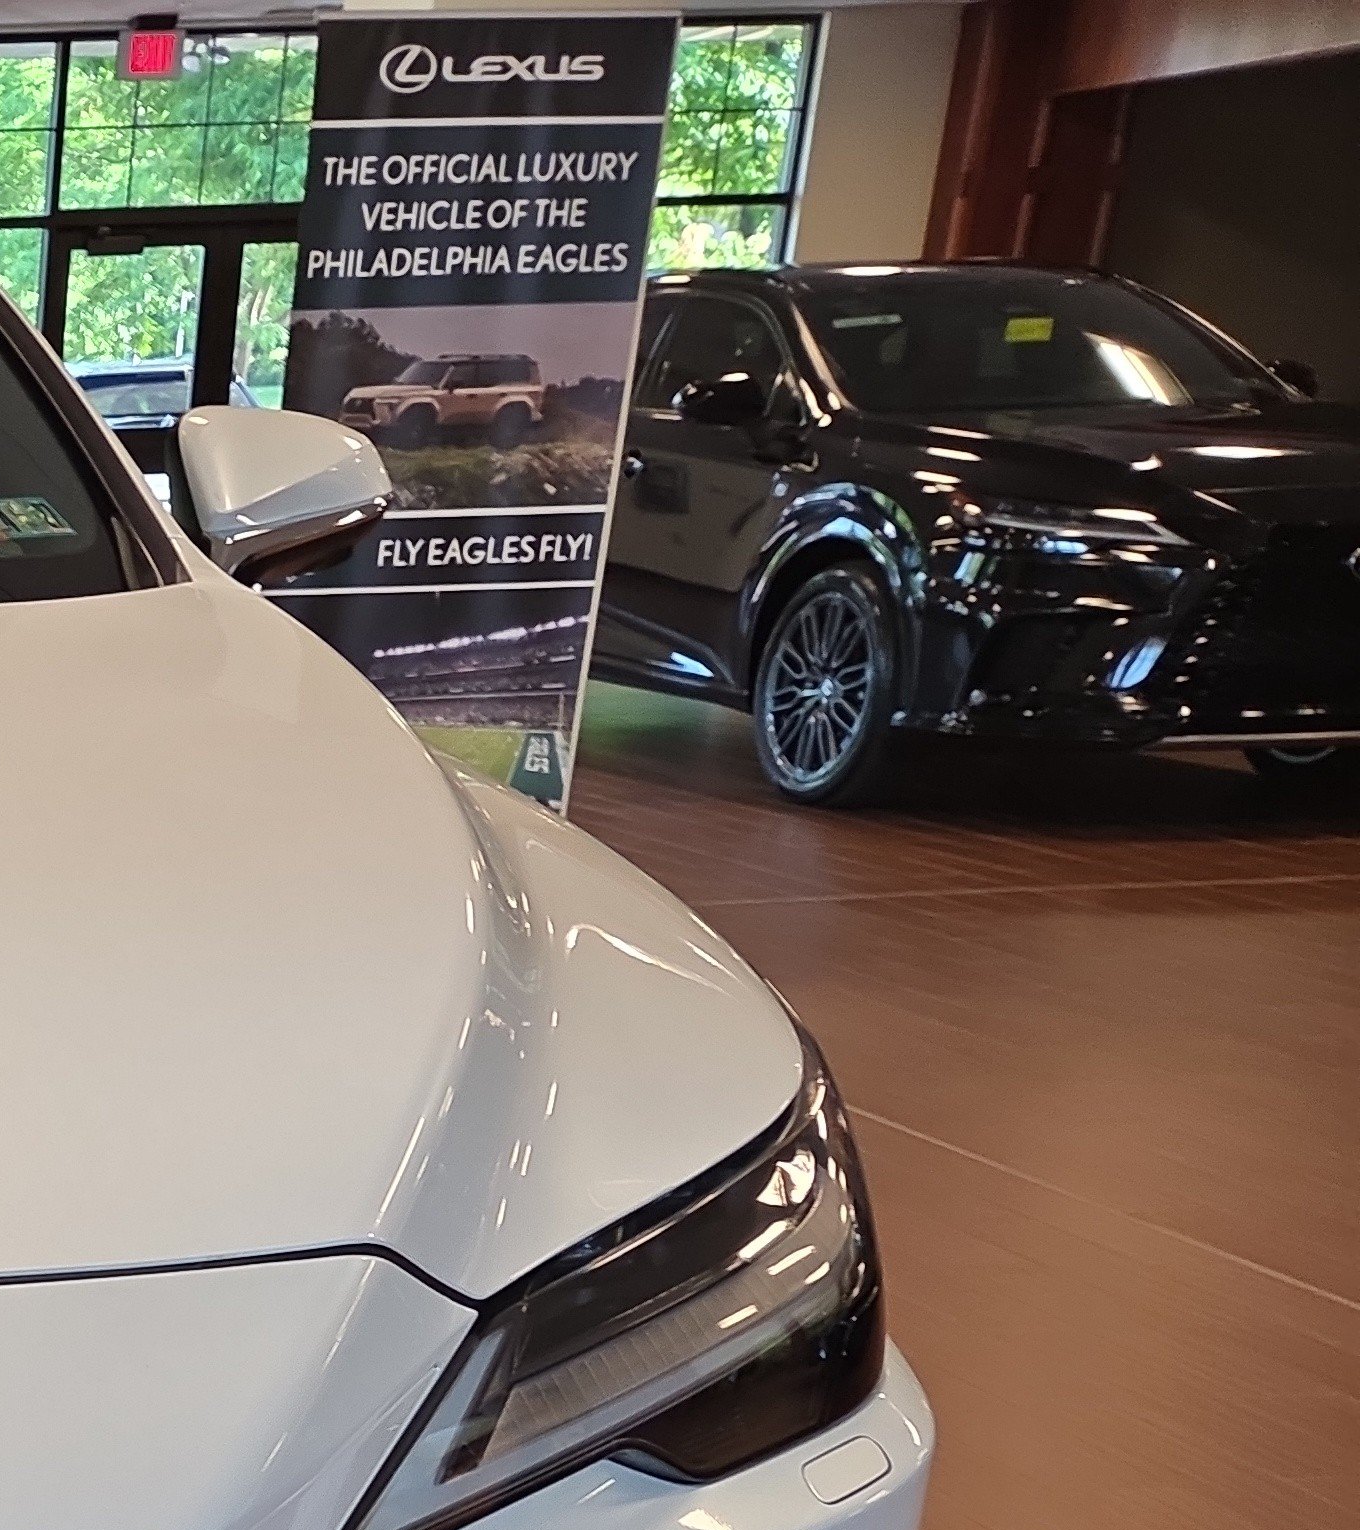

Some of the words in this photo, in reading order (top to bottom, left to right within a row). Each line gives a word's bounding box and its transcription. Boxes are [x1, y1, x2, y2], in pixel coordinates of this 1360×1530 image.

[442, 55, 605, 82] LEXUS
[323, 156, 378, 186] THE
[382, 153, 512, 185] OFFICIAL
[517, 151, 638, 182] LUXURY
[362, 200, 483, 231] VEHICLE
[487, 199, 530, 229] OF
[534, 198, 588, 228] THE
[307, 245, 511, 279] PHILADELPHIA
[517, 242, 629, 274] EAGLES
[377, 538, 425, 567] FLY
[427, 536, 536, 566] EAGLES
[539, 533, 593, 562] FLY!
